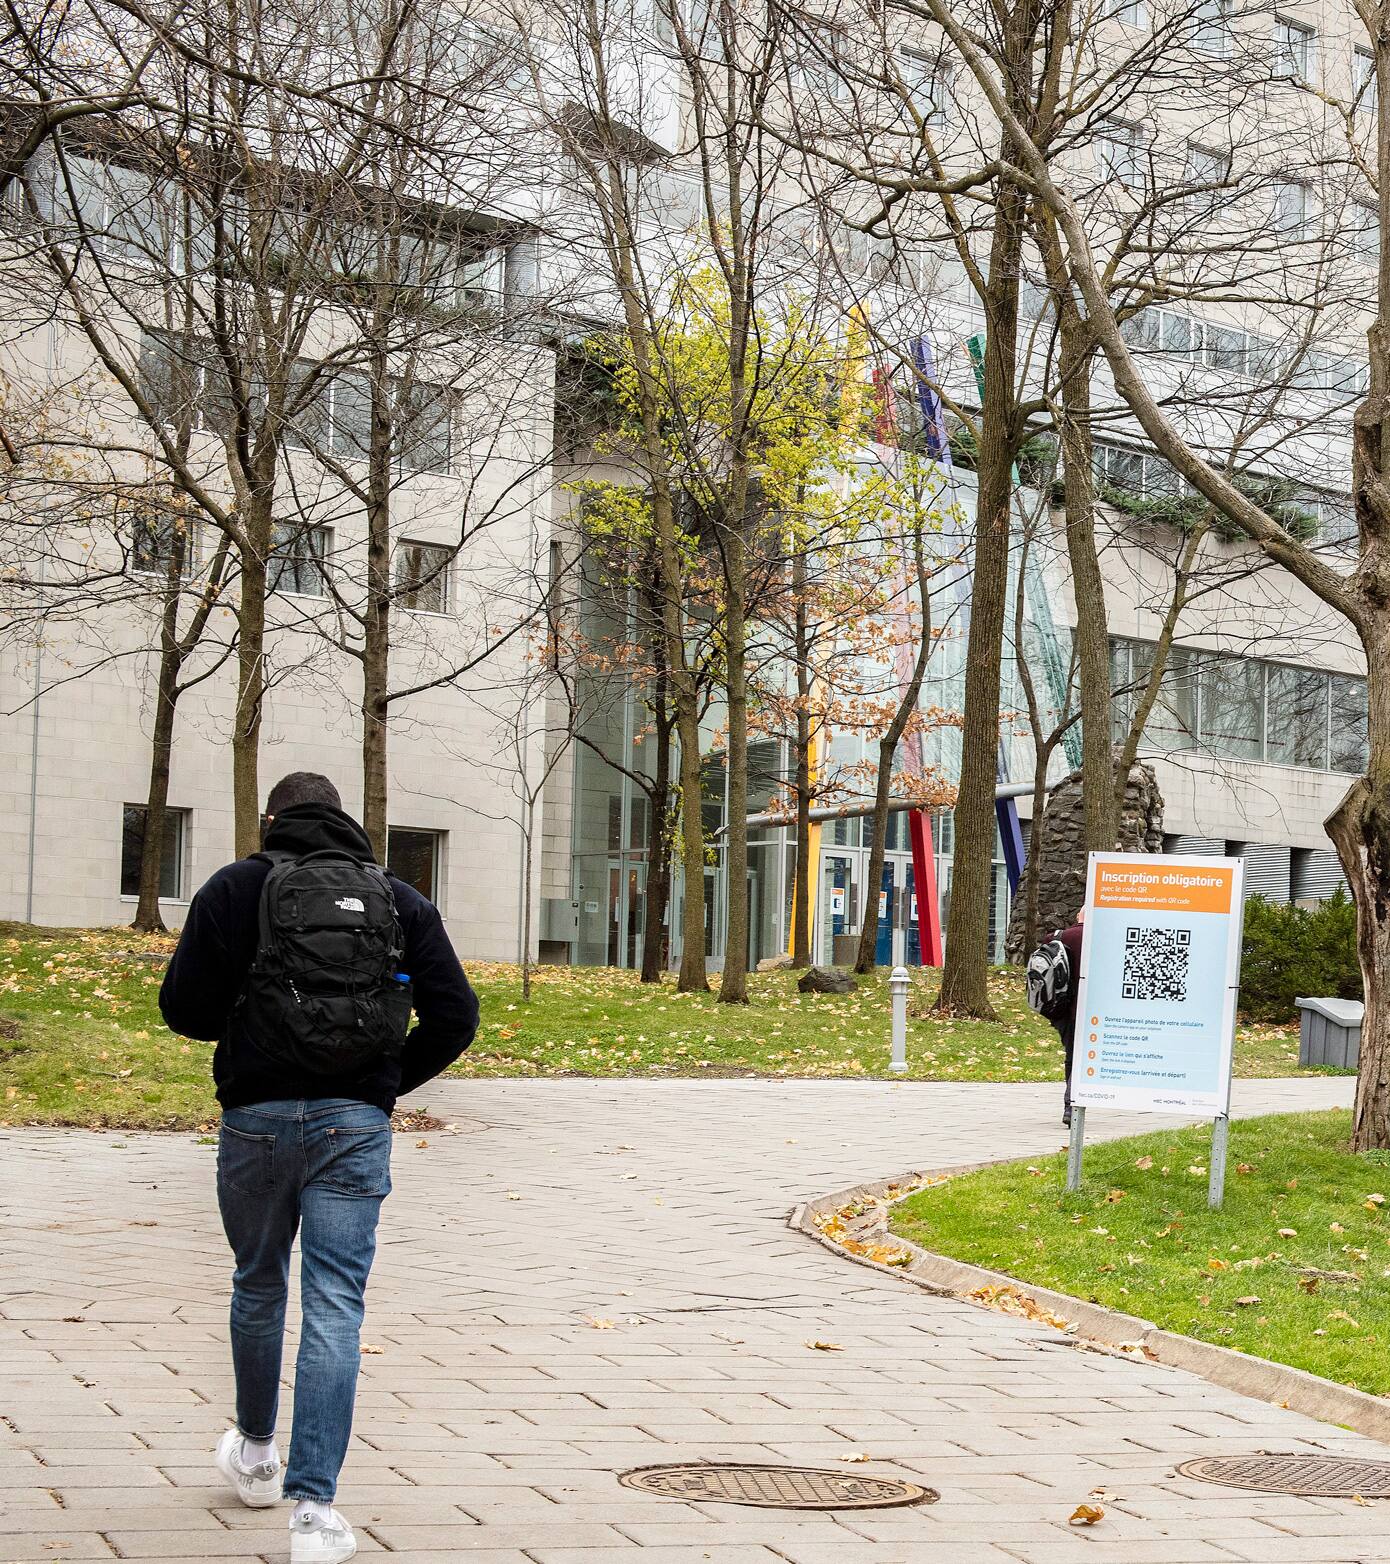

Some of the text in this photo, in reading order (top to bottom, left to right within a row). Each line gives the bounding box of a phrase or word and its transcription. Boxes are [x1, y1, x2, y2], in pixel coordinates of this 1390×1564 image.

[1101, 871, 1223, 888] Inscription obligatoire
[1099, 894, 1131, 902] Registration
[1131, 896, 1157, 904] required
